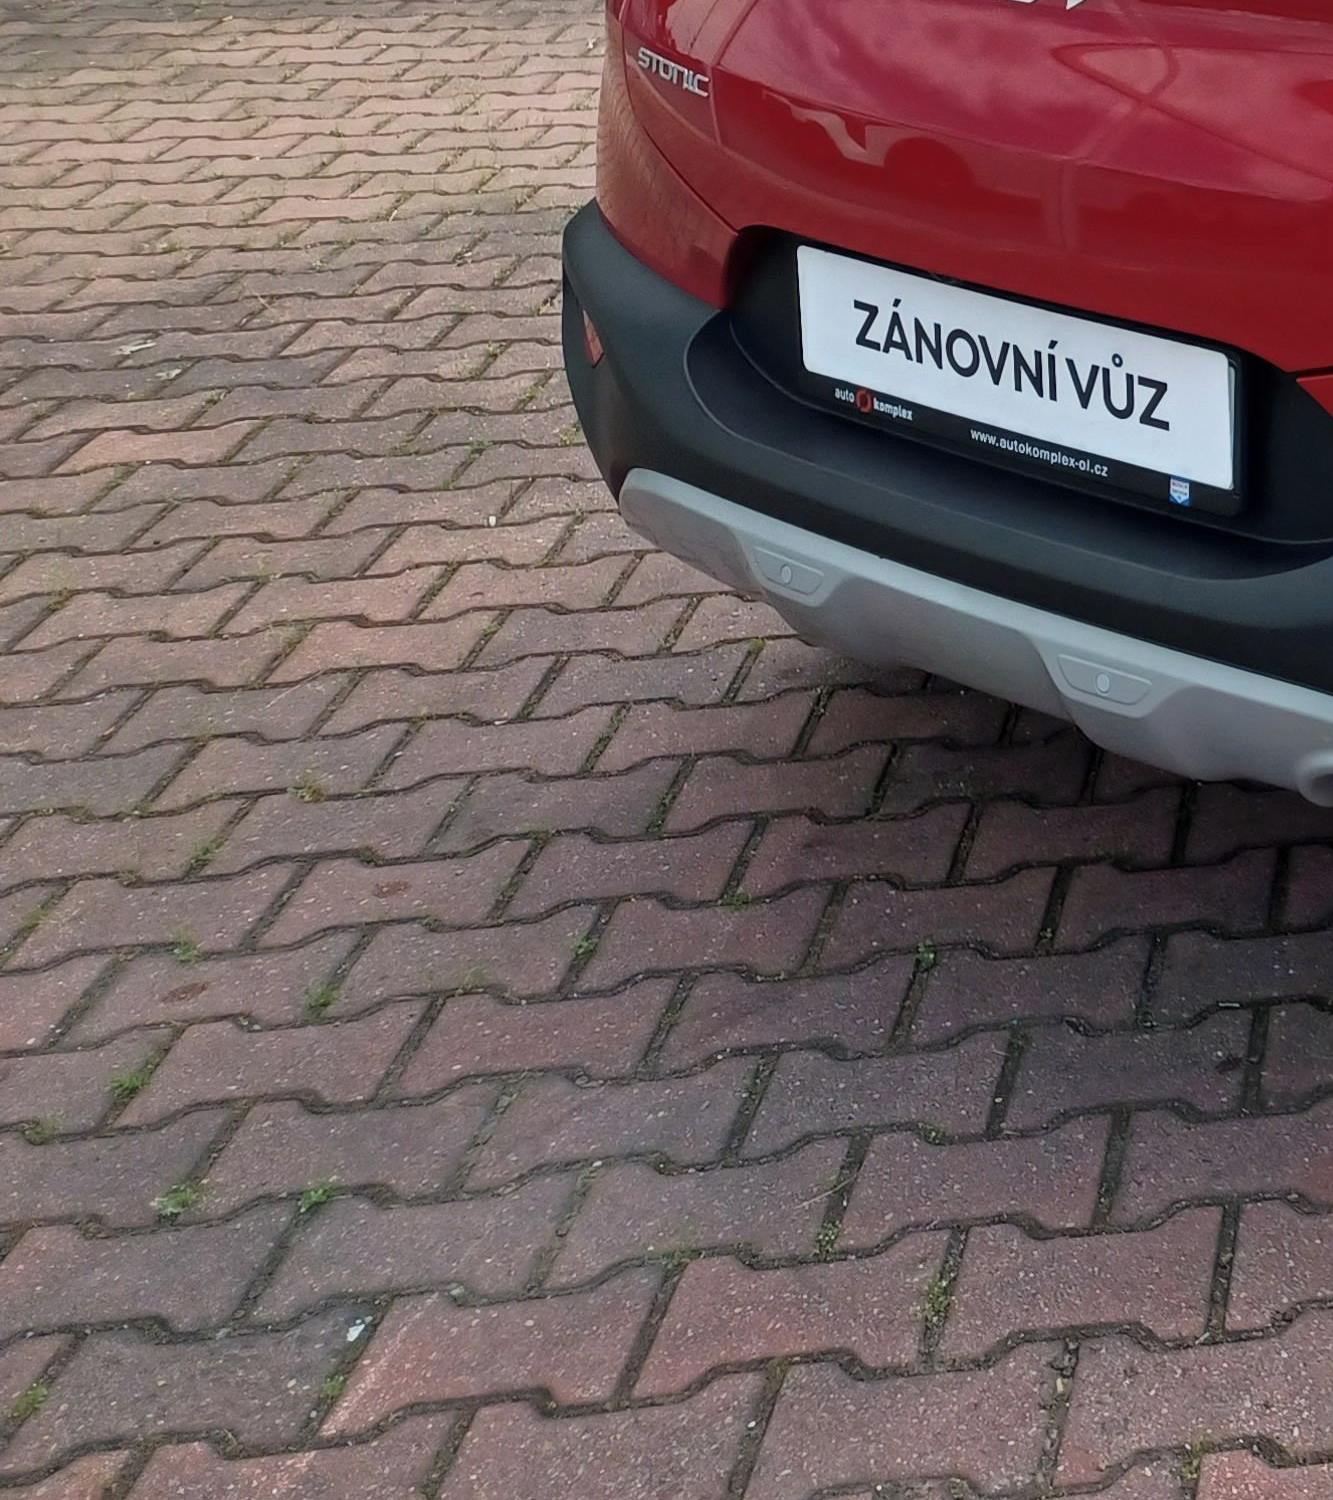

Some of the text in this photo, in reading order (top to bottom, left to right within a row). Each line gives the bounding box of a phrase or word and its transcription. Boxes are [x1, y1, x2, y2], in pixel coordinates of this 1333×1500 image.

[638, 46, 710, 98] STONIC
[853, 298, 1170, 431] ZÁNOVNÍ VŮZ
[834, 387, 913, 421] auto komplex
[970, 428, 1109, 477] www.autokomplex-ol.cz
